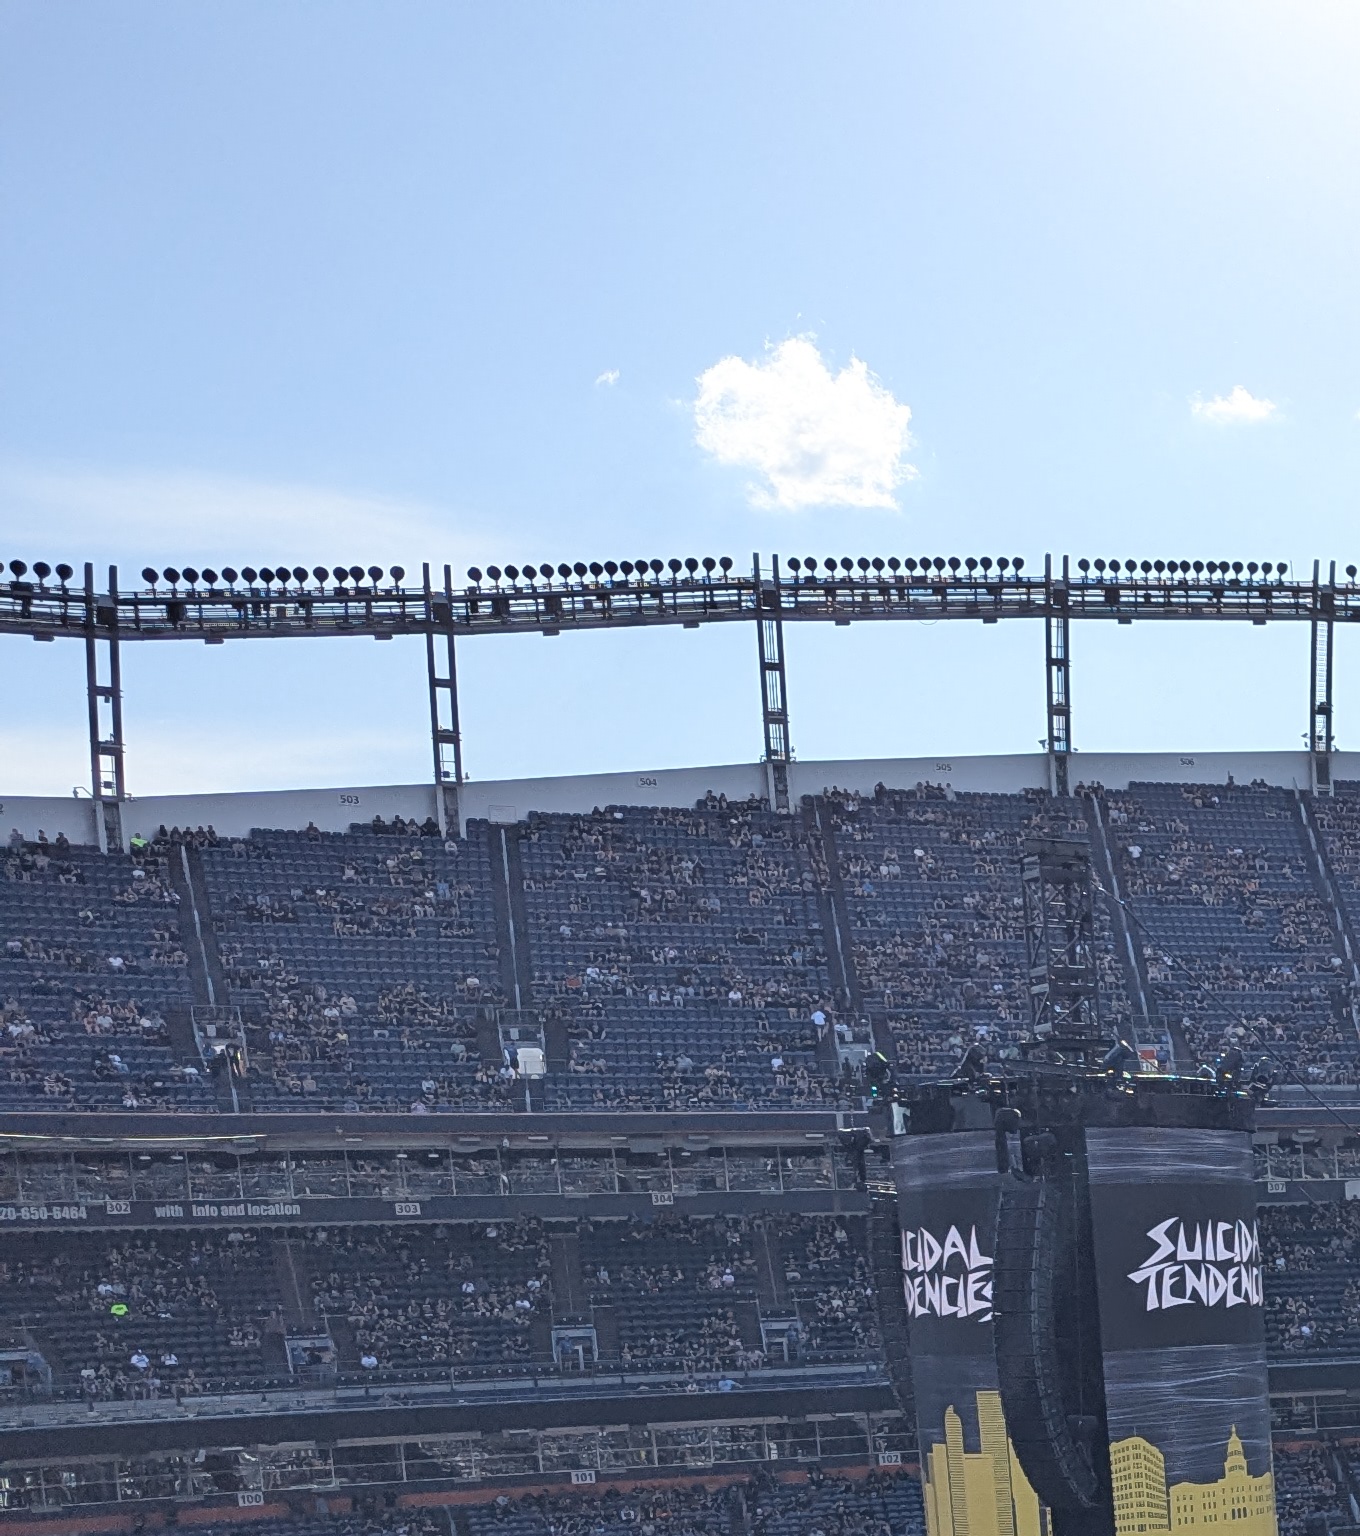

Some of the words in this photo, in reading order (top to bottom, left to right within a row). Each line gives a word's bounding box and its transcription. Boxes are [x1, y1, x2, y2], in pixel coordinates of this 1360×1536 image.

[936, 763, 952, 772] 505
[640, 777, 657, 787] 504
[340, 795, 359, 805] 503
[654, 1194, 672, 1203] 304
[109, 1204, 129, 1212] 302
[155, 1205, 184, 1218] with
[221, 1204, 246, 1216] and
[248, 1202, 301, 1216] location
[398, 1205, 418, 1214] 303
[882, 1454, 900, 1463] 102
[575, 1473, 593, 1482] 101
[242, 1494, 261, 1504] 100
